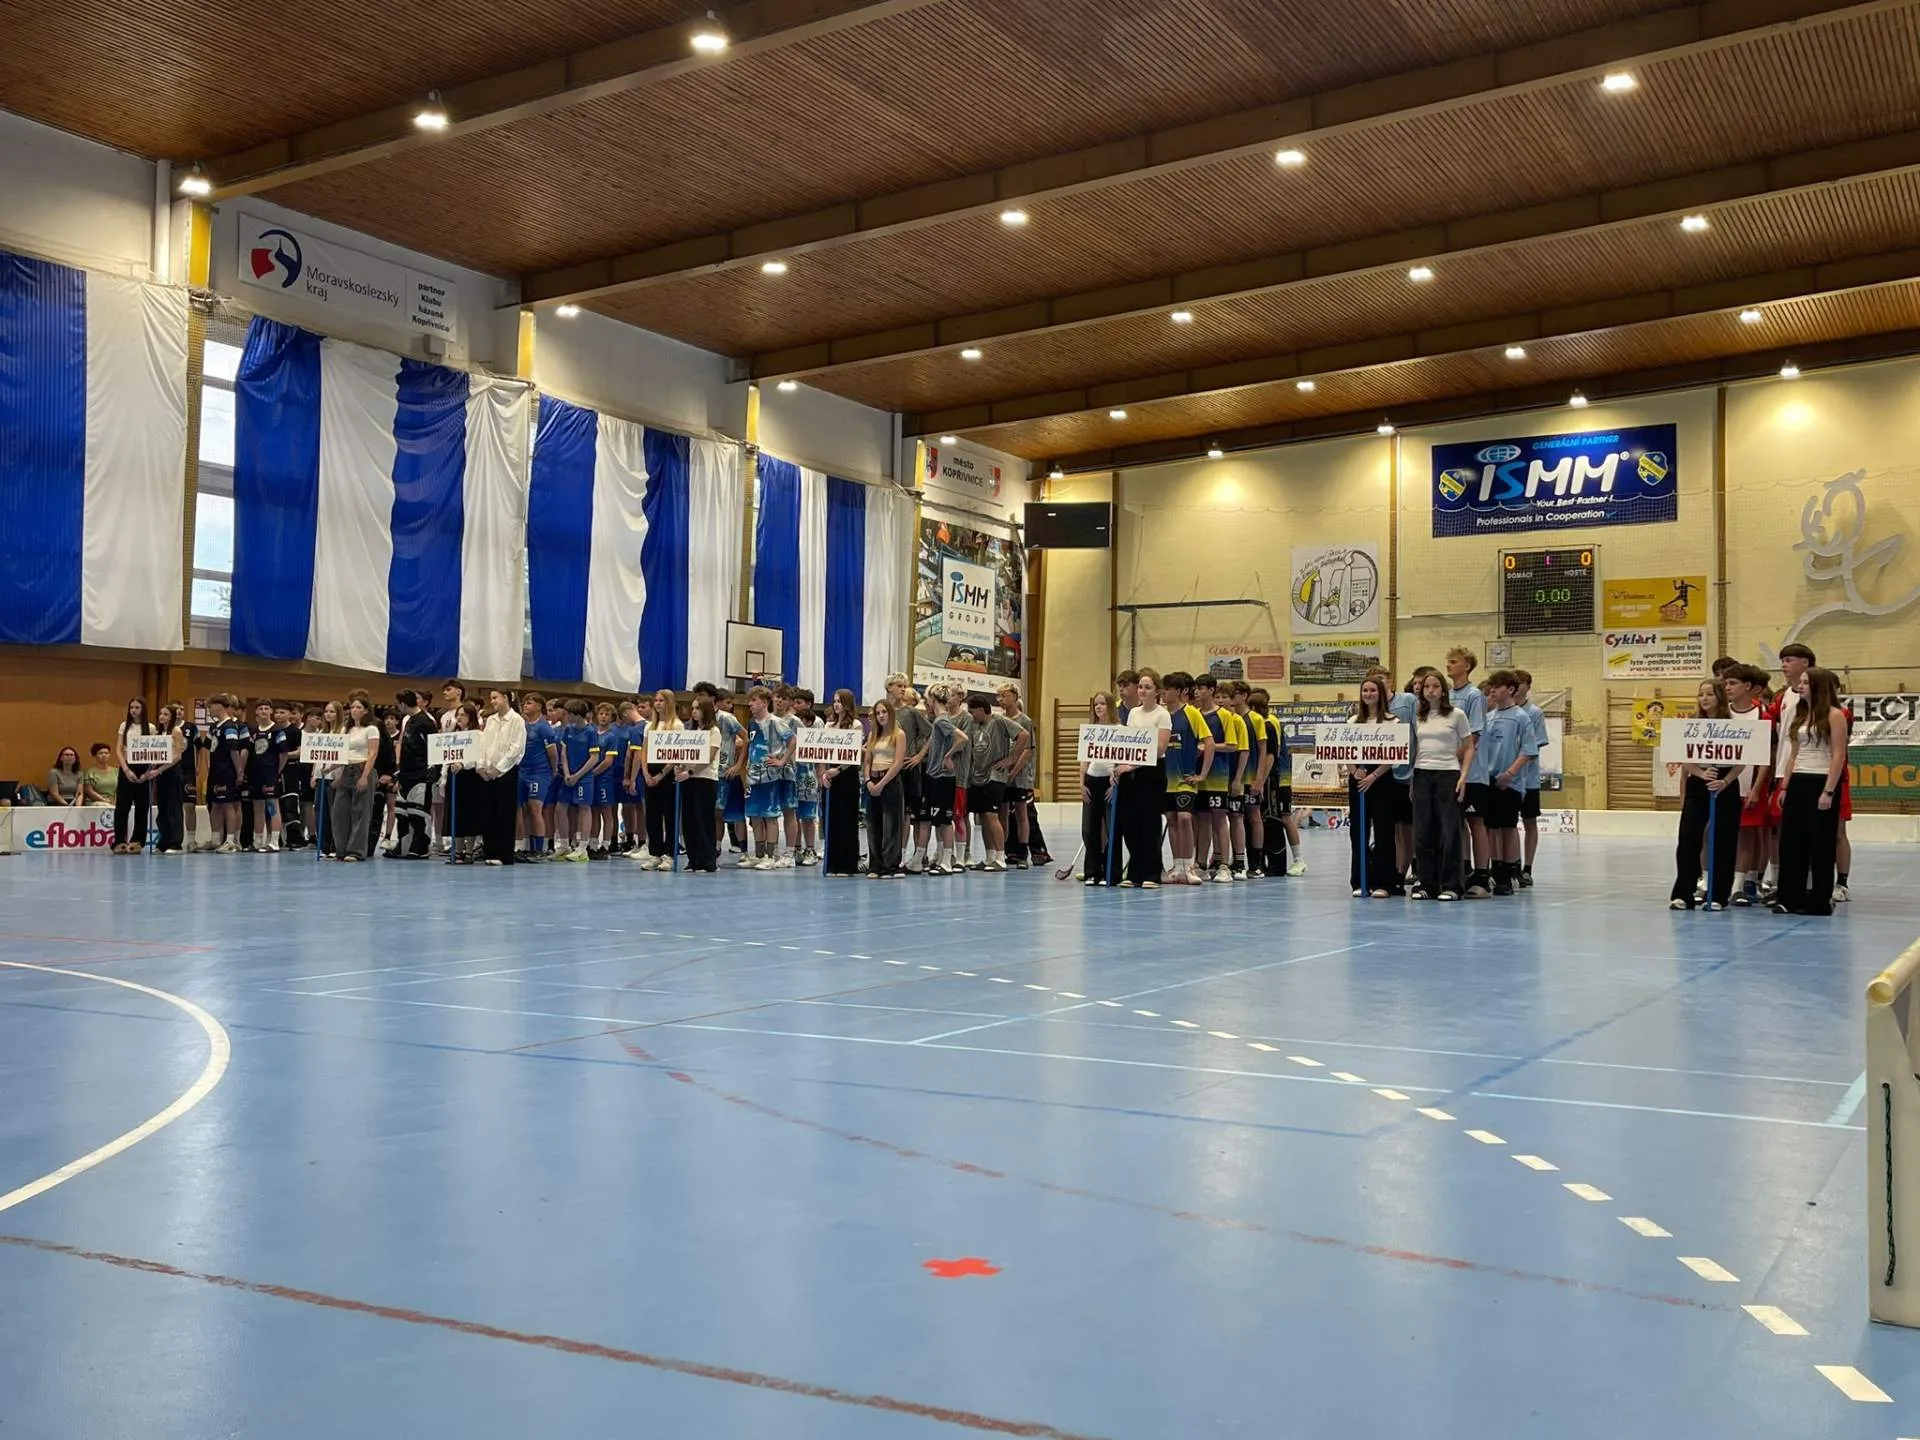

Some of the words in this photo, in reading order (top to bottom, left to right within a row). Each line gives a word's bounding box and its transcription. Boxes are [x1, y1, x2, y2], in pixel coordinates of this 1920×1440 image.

[306, 265, 399, 308] Moravskoslezský
[306, 280, 328, 302] kraj
[418, 283, 445, 296] partner
[421, 294, 442, 307] Klubu
[1532, 436, 1579, 450] GENERÁLNÍ
[1581, 434, 1620, 446] PARTNER
[953, 457, 974, 470] město
[942, 465, 984, 488] KOPŘIVNICE
[1479, 453, 1619, 501] ISMM
[1536, 499, 1556, 508] Your
[1557, 498, 1575, 507] Best
[1576, 496, 1607, 505] Partner
[1476, 513, 1533, 526] Professionals
[1534, 513, 1544, 522] in
[1545, 509, 1605, 523] Cooperation
[1505, 555, 1516, 570] 0
[1580, 551, 1592, 566] 0
[949, 611, 986, 624] GROUP
[1343, 640, 1376, 648] CENTRUM
[1838, 695, 1919, 722] LECT
[1851, 728, 1910, 738] ompanies.cz
[131, 748, 168, 761] KOPŘIVNICE
[310, 749, 339, 761] OSTRAVA
[443, 748, 464, 761] PÍSEK
[656, 748, 701, 760] CHOMUTOV
[798, 746, 834, 760] KARLOVY
[837, 748, 859, 762] VARY
[1087, 742, 1148, 762] ČELÁKOVICE
[1316, 745, 1358, 761] HRADEC
[1361, 743, 1409, 761] KRÁLOVÉ
[1686, 740, 1743, 761] VYŠKOV
[530, 782, 539, 793] 13
[578, 786, 584, 797] 8
